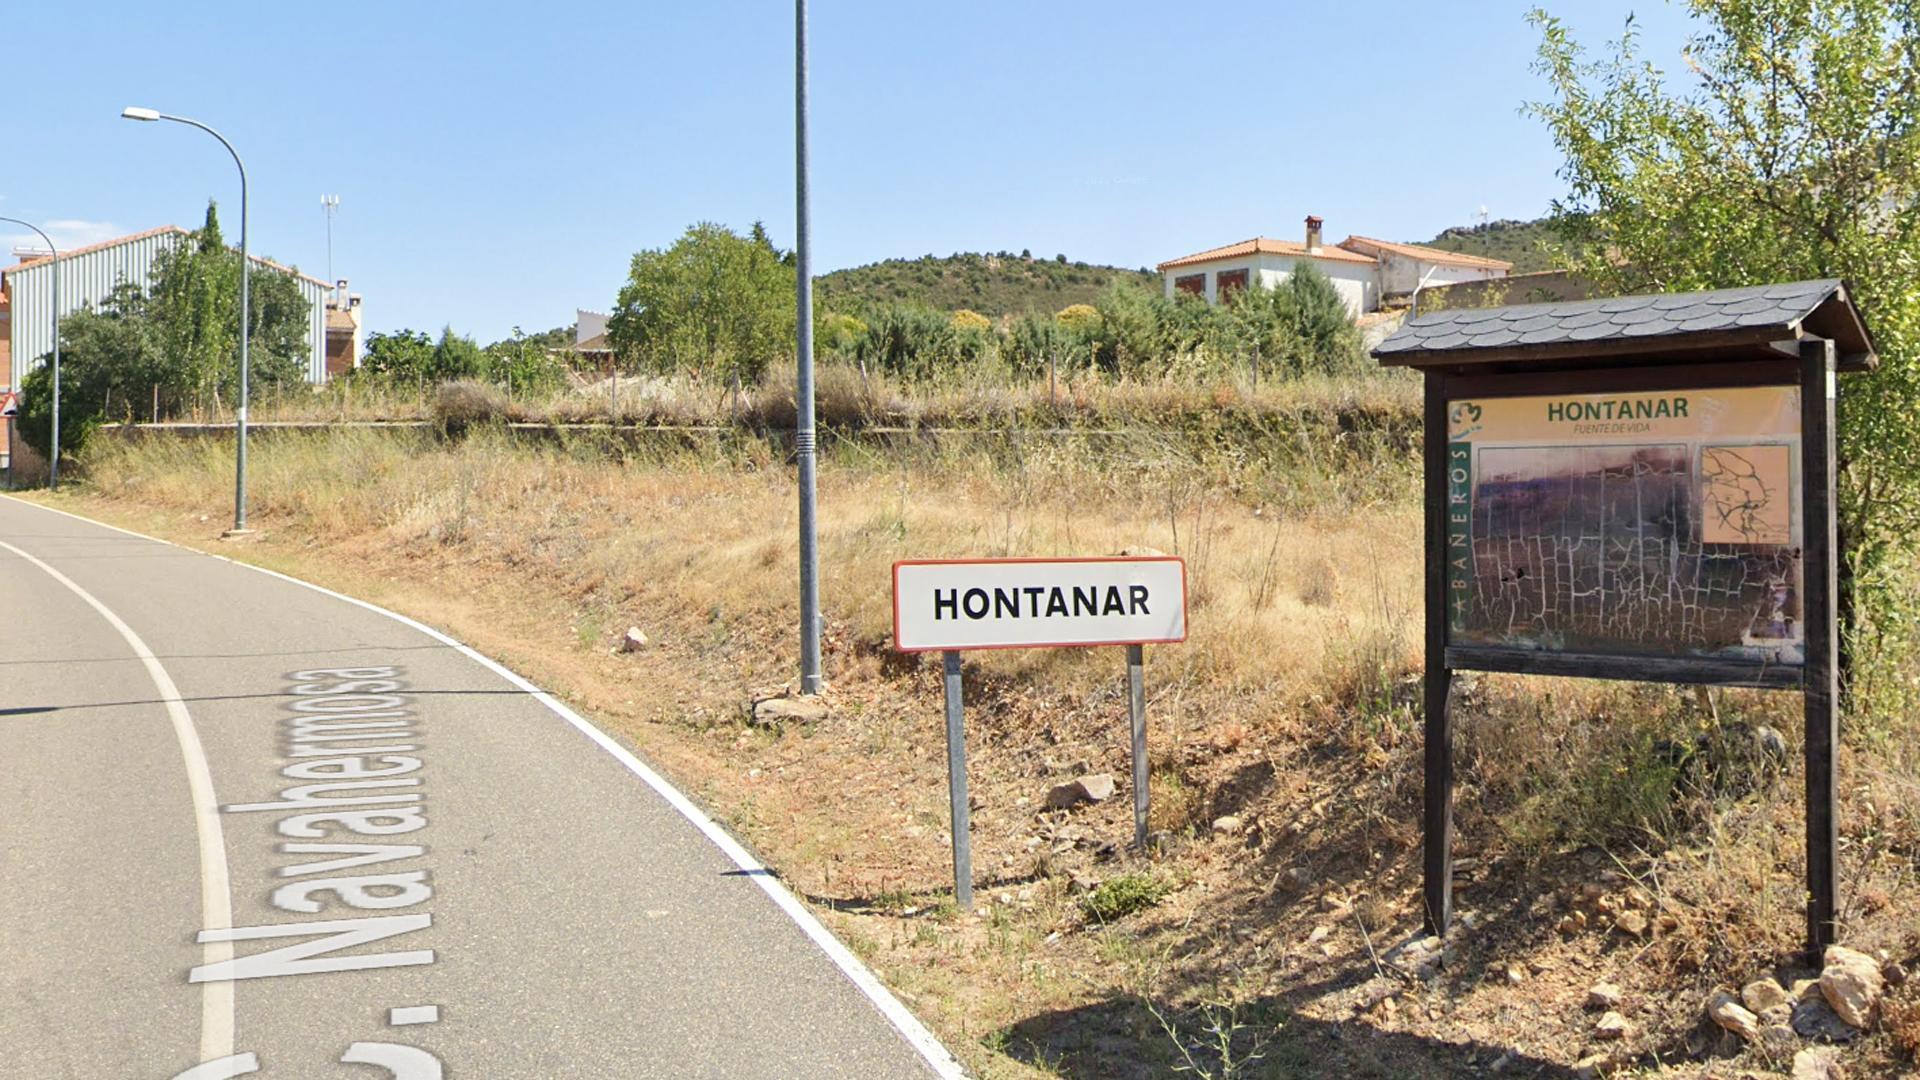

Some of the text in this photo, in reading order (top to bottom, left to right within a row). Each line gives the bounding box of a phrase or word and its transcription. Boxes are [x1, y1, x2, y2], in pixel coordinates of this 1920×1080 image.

[1548, 397, 1689, 422] HONTANAR
[1574, 422, 1650, 434] FUENTE DE VIDA
[934, 585, 1150, 620] HONTANAR
